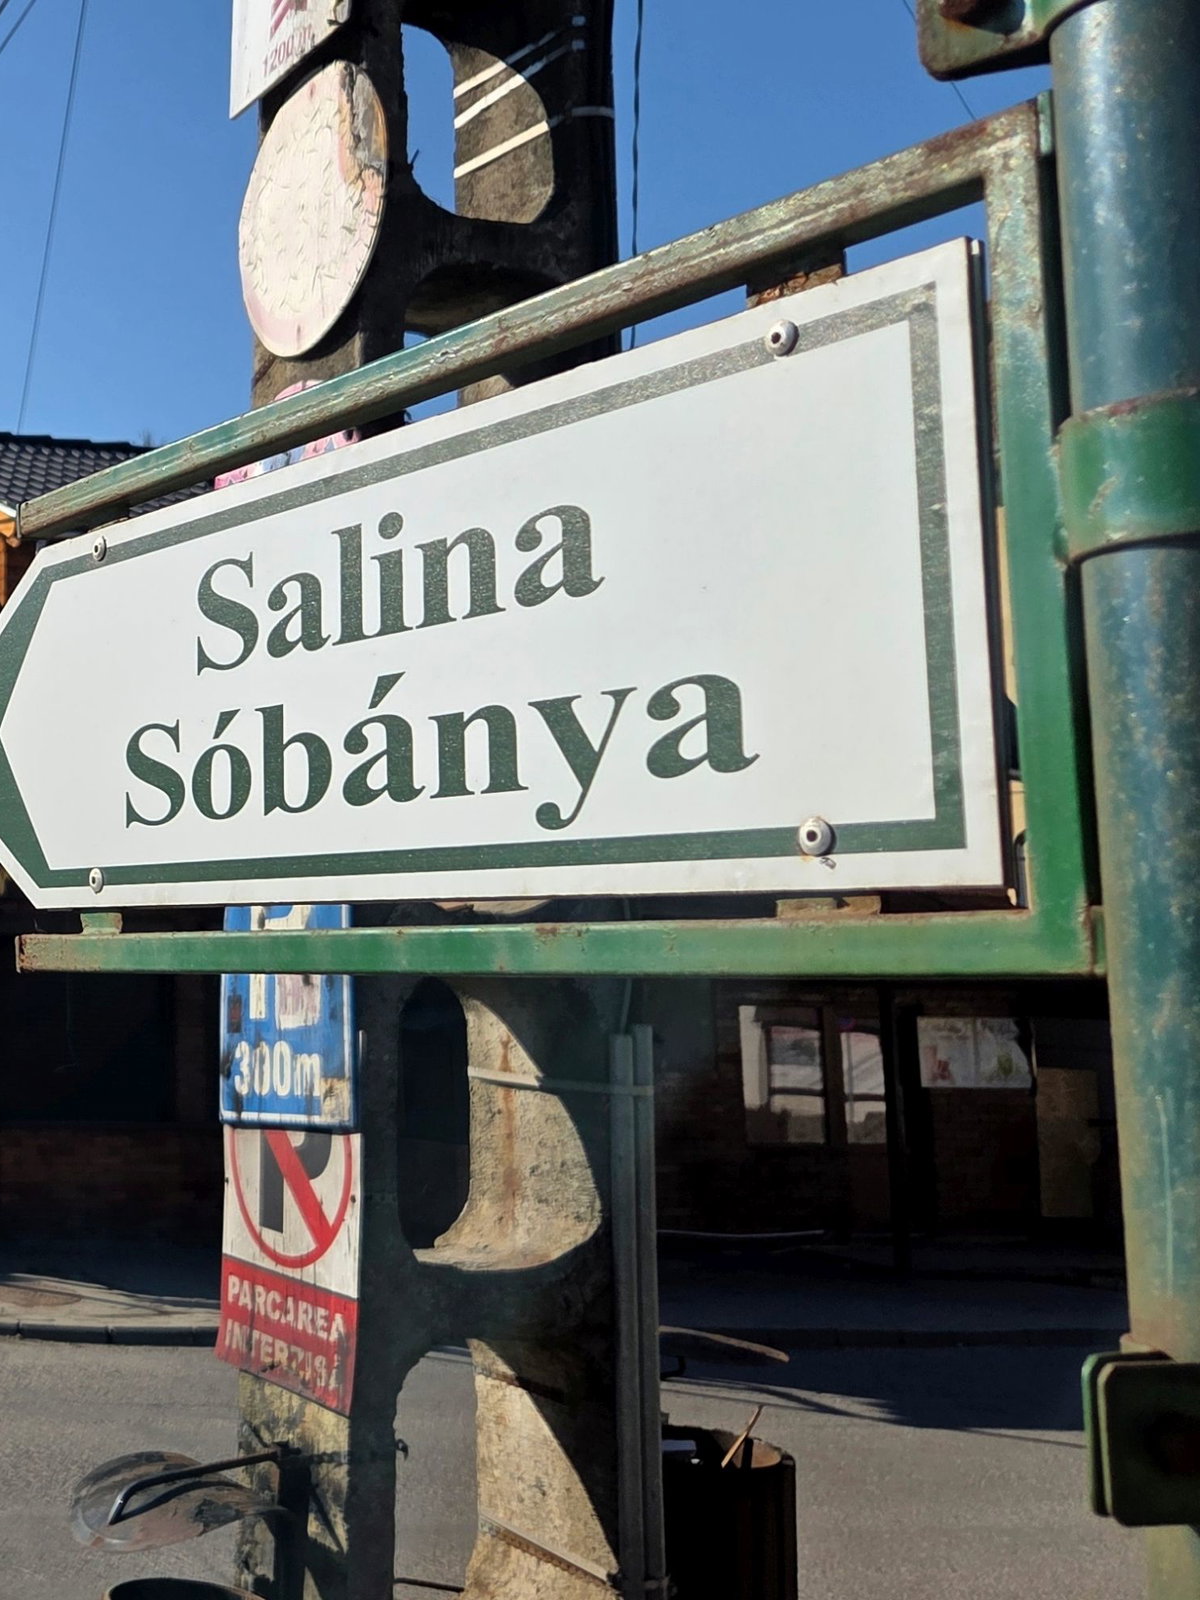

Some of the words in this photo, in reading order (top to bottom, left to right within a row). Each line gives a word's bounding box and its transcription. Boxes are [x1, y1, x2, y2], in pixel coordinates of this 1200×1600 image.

[197, 504, 605, 675] Salina
[125, 671, 760, 829] Sóbánya
[234, 1040, 321, 1097] 300m
[227, 1273, 346, 1343] PARCAREA
